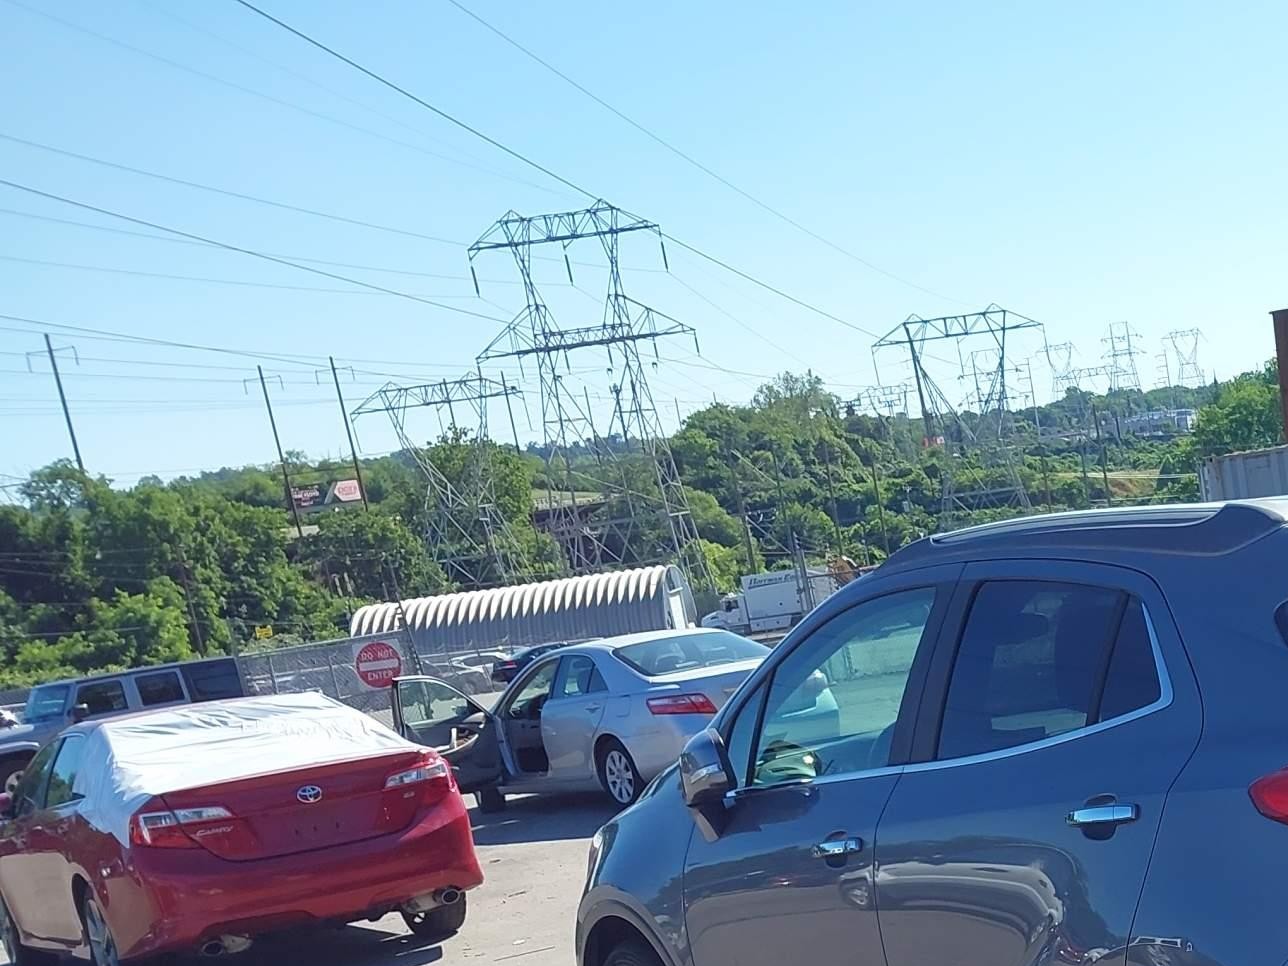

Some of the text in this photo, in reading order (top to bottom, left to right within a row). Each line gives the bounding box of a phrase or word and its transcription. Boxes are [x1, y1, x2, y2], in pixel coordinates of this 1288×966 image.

[361, 648, 393, 661] DO NOT
[367, 670, 393, 681] ENTER
